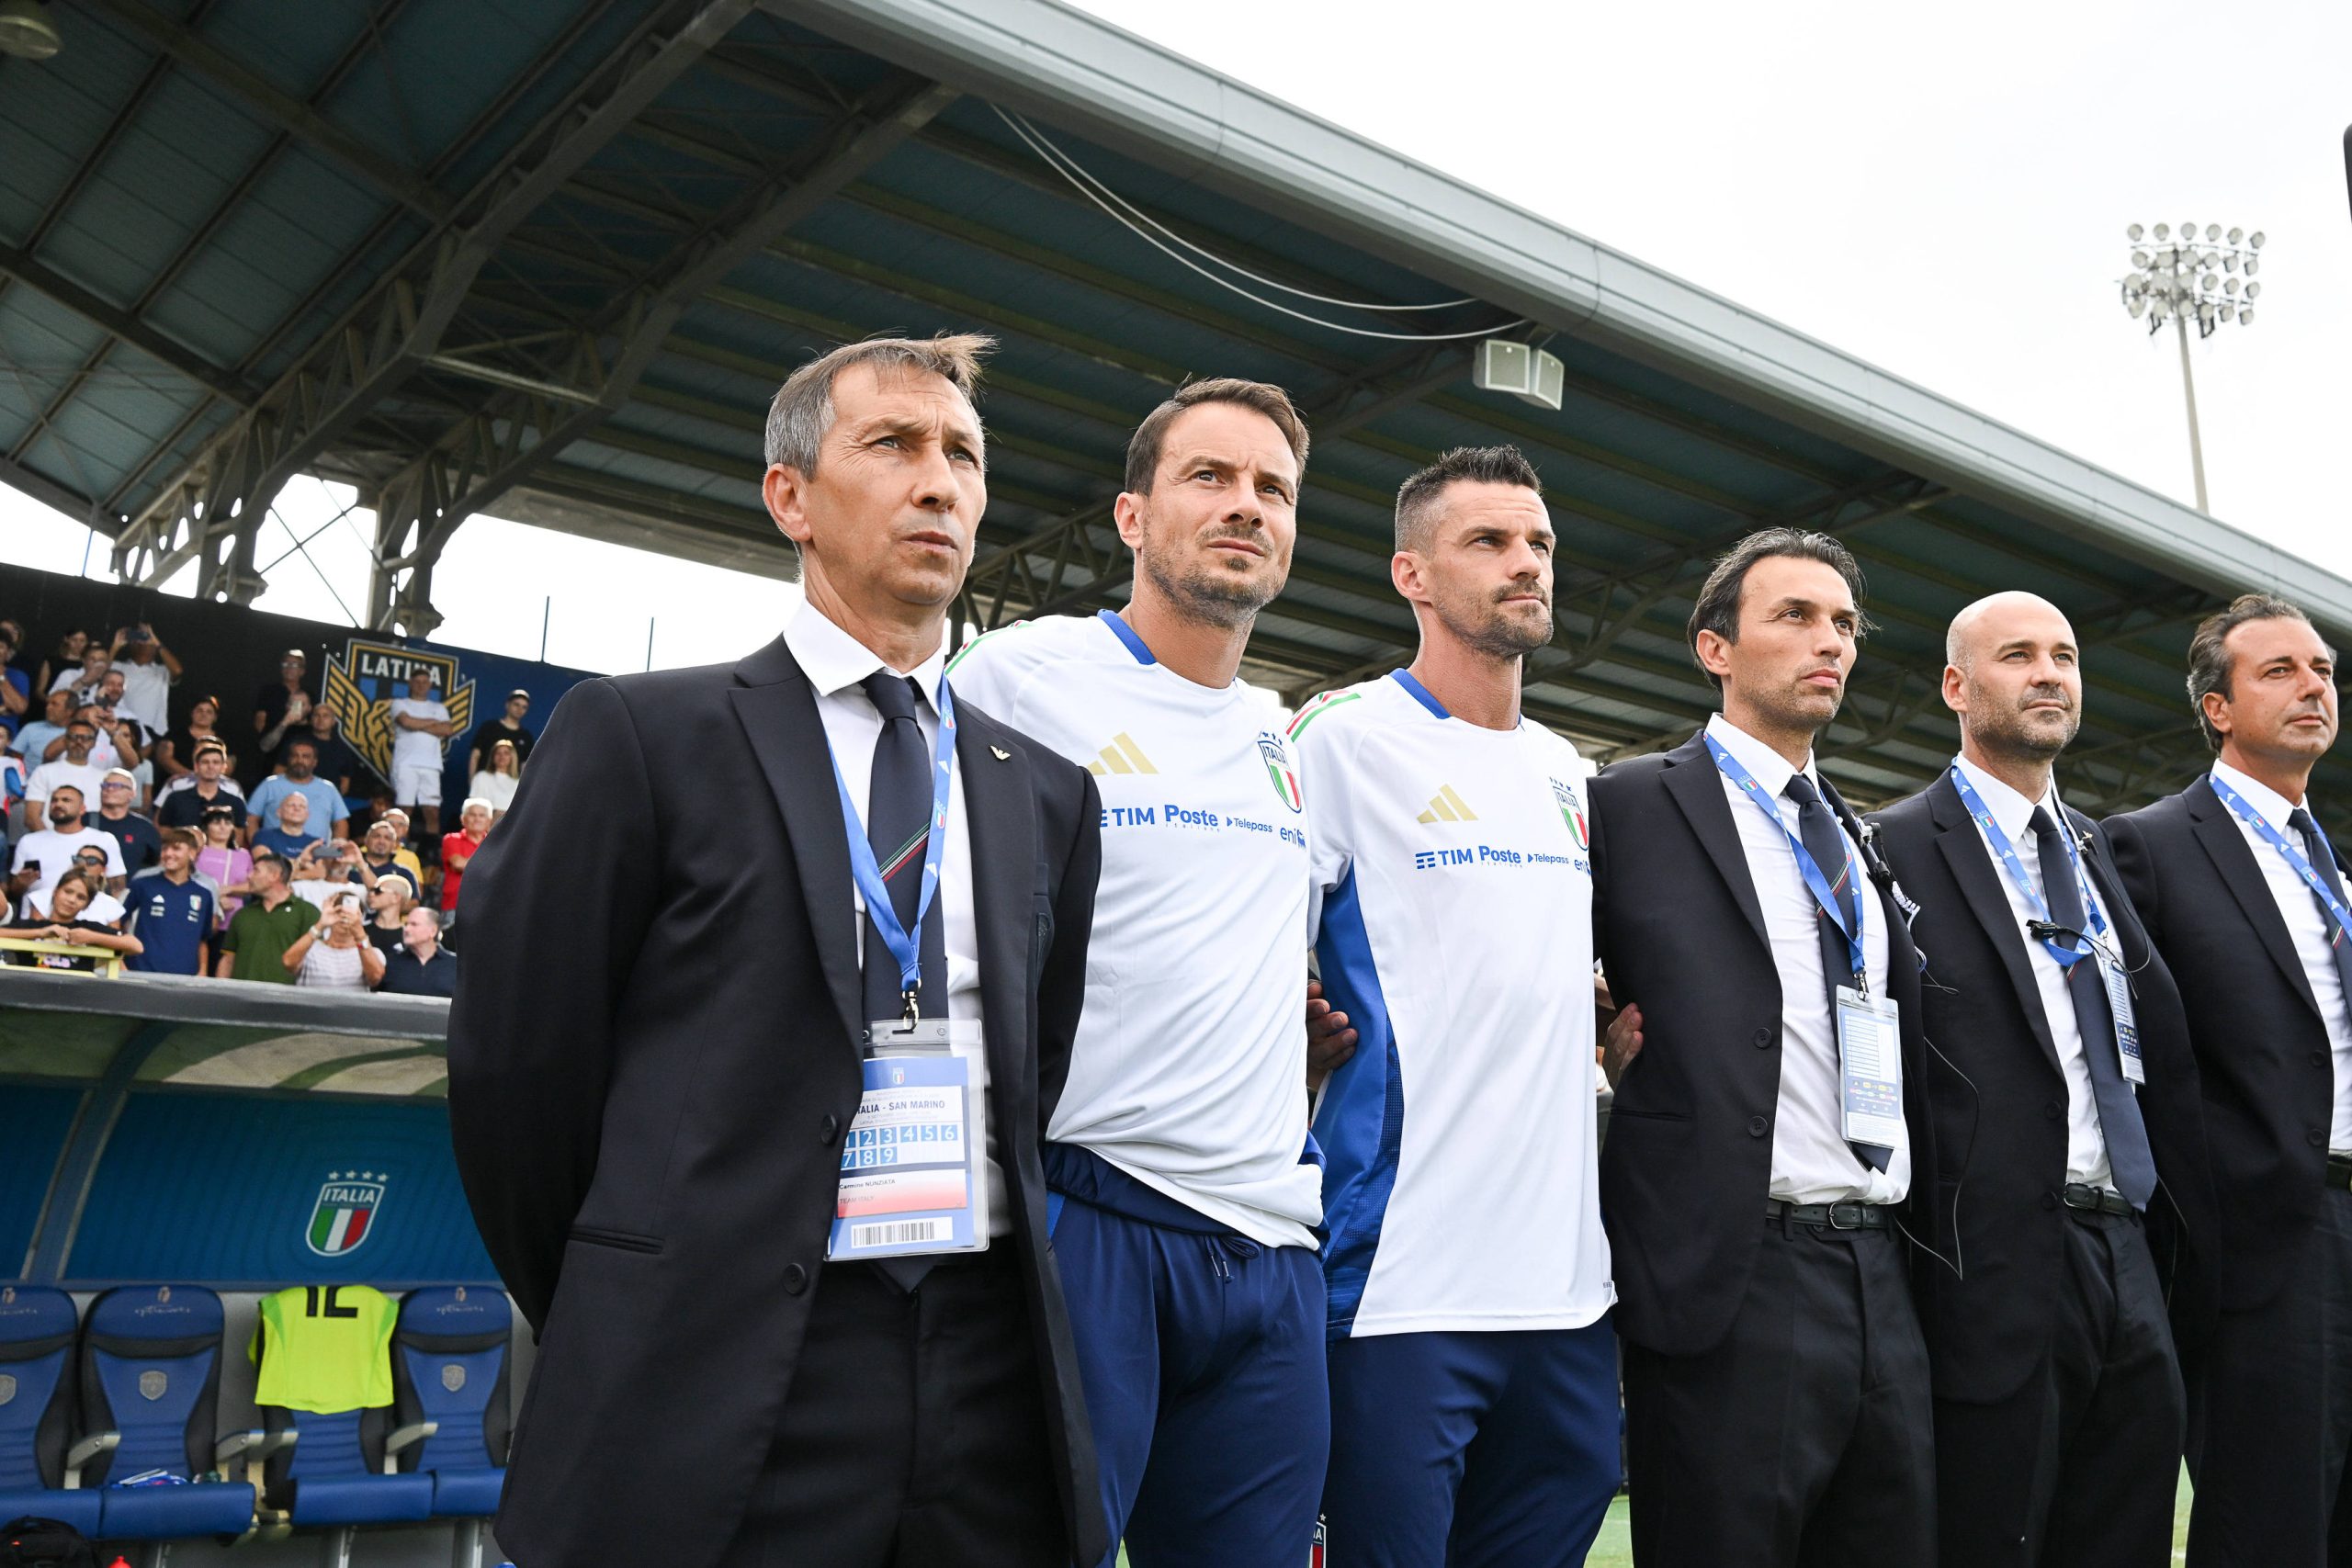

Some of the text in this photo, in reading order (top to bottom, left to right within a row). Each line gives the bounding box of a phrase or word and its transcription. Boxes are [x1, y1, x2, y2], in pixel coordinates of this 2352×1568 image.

[1261, 745, 1286, 763] ITALIA
[1112, 807, 1156, 827] TIM
[1164, 804, 1219, 827] Poste
[1233, 818, 1273, 833] Telepass
[1438, 848, 1474, 865] TIM
[1478, 845, 1521, 864] Poste
[1533, 853, 1569, 865] Telepass
[888, 1101, 908, 1111] SAN
[910, 1100, 945, 1110] MARINO
[863, 1131, 874, 1145] 2
[884, 1128, 893, 1143] 3
[903, 1126, 914, 1141] 4
[925, 1125, 934, 1140] 5
[944, 1125, 955, 1140] 6
[842, 1148, 894, 1167] 7 8 9
[323, 1188, 375, 1202] ITALIA
